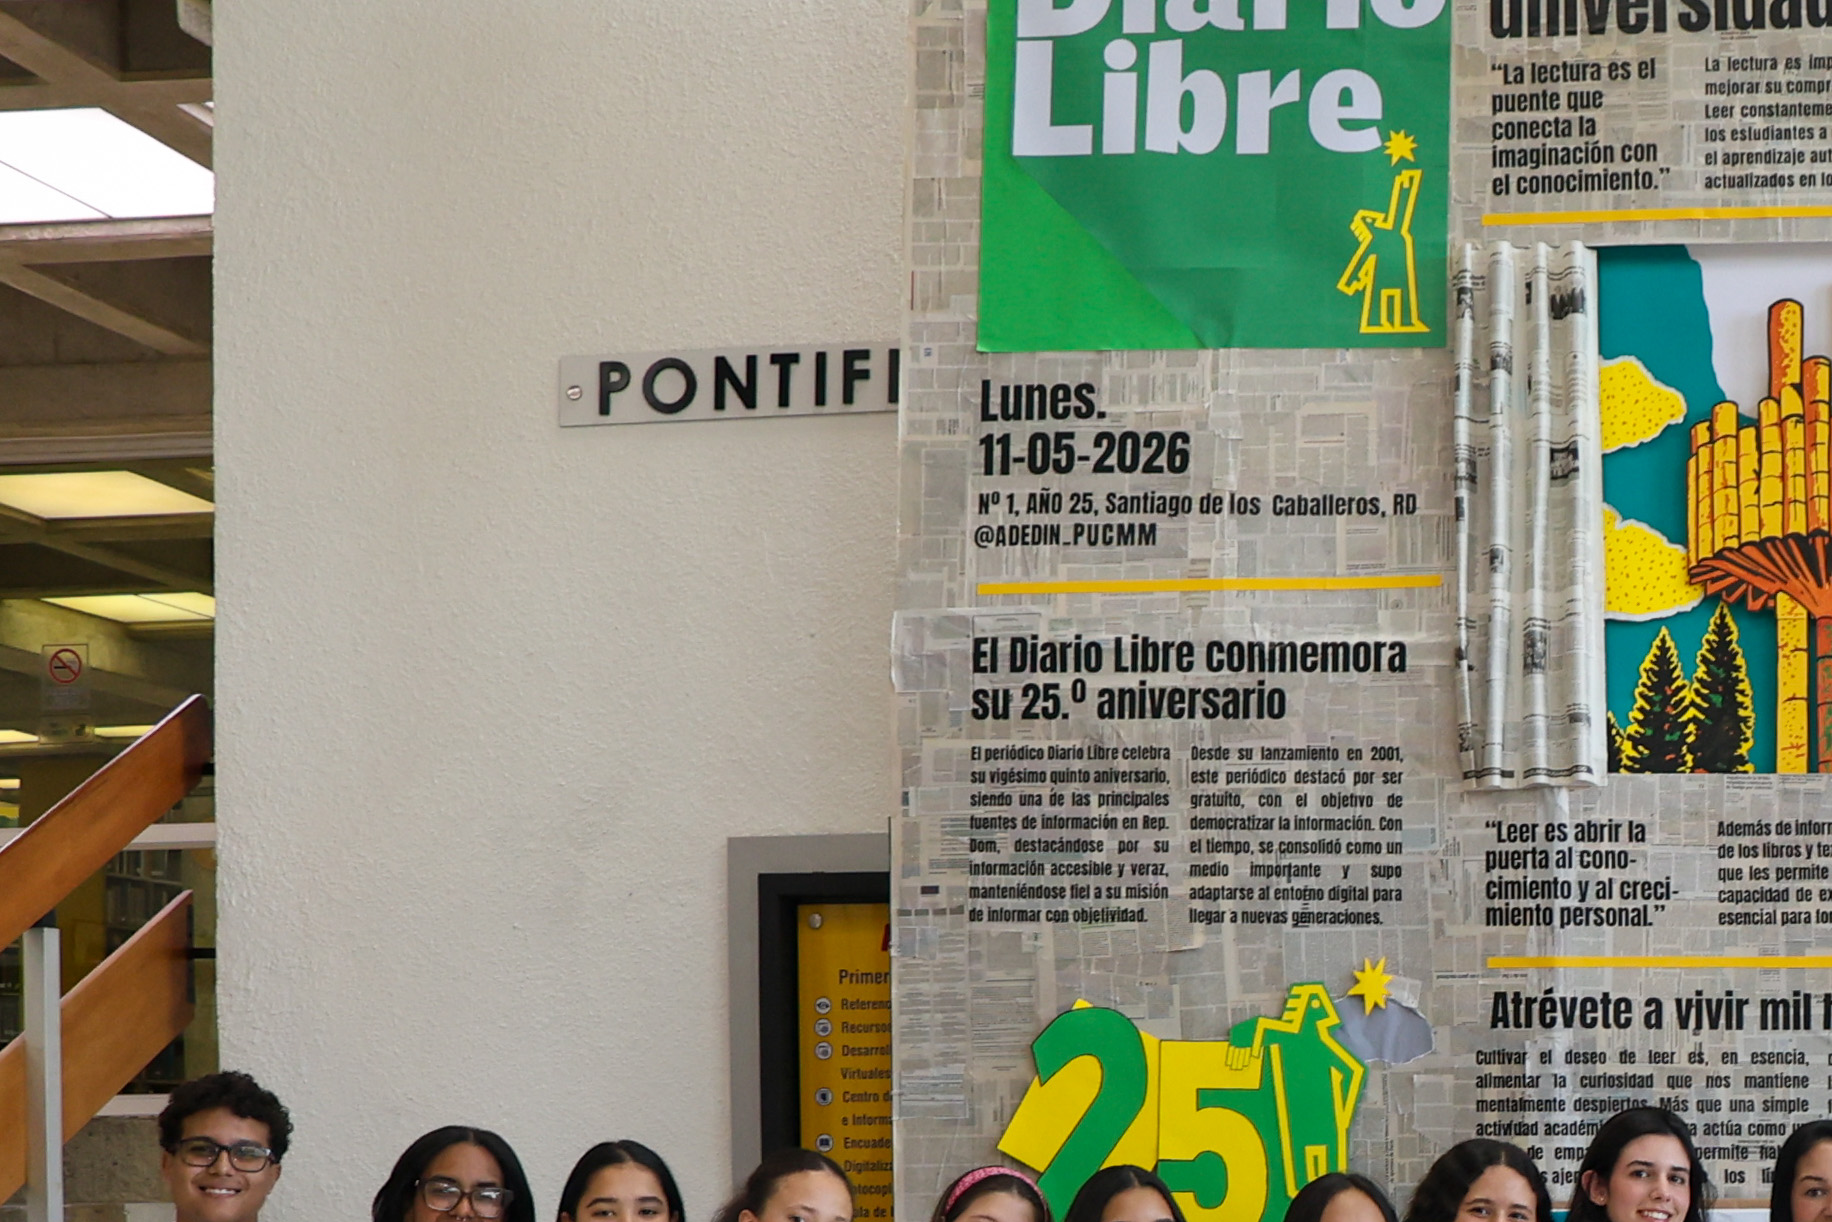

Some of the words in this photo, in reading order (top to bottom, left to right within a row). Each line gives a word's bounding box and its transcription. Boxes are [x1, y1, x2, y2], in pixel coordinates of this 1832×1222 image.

[1531, 61, 1601, 83] lectura
[1608, 60, 1632, 81] es
[1637, 57, 1656, 79] el
[1012, 39, 1383, 157] Libre
[1492, 89, 1561, 116] puente
[1567, 89, 1604, 112] que
[1492, 117, 1572, 140] conecta
[1578, 115, 1596, 136] la
[1492, 141, 1614, 169] imaginación
[1621, 142, 1657, 163] con
[1492, 174, 1510, 195] el
[1705, 172, 1794, 189] actualizados
[1800, 174, 1817, 188] en
[979, 379, 1107, 422] Lunes.
[978, 431, 1190, 476] 11-05-2026
[1005, 493, 1020, 517] 1,
[1026, 487, 1062, 514] AÑO
[1068, 492, 1098, 517] 25,
[1105, 490, 1193, 519] Santiago
[1200, 493, 1223, 515] de
[1230, 492, 1261, 515] los
[1272, 493, 1387, 518] Caballeros,
[1393, 493, 1417, 516] RD
[974, 522, 1157, 548] @ADEDIN_PUCMM
[972, 637, 998, 673] El
[1009, 634, 1103, 673] Diario
[1114, 635, 1195, 673] Libre
[1206, 640, 1407, 673] conmemora
[971, 687, 1010, 721] su
[1097, 680, 1286, 720] aniversario
[971, 746, 981, 760] El
[985, 745, 1044, 762] periódico
[1047, 746, 1083, 760] Diario
[1087, 745, 1118, 760] Libre
[1121, 746, 1170, 760] celebra
[1191, 746, 1230, 760] Desde
[1238, 747, 1253, 760] su
[1261, 746, 1339, 760] lanzamiento
[1347, 748, 1363, 760] en
[1370, 746, 1404, 762] 2001,
[970, 771, 985, 784] su
[989, 768, 1047, 786] vigésimo
[1050, 768, 1090, 786] quinto
[1093, 768, 1170, 785] aniversario,
[970, 792, 1012, 806] siendo
[1019, 794, 1042, 806] una
[1049, 792, 1065, 806] de
[1071, 792, 1091, 806] las
[1098, 791, 1170, 808] principales
[1544, 822, 1568, 843] es
[1574, 819, 1622, 843] abrir
[1628, 820, 1646, 843] la
[1485, 847, 1549, 872] puerta
[1555, 846, 1573, 869] al
[1579, 850, 1637, 869] cono-
[1485, 876, 1572, 900] cimiento
[1578, 880, 1590, 903] y
[1595, 878, 1613, 900] al
[1619, 876, 1679, 900] creci-
[1485, 903, 1554, 927] miento
[1719, 907, 1776, 926] esencial
[1781, 909, 1811, 927] para
[1490, 987, 1633, 1030] Atrévete
[1643, 996, 1663, 1030] a
[1674, 990, 1749, 1031] vivir
[1759, 990, 1811, 1031] mil
